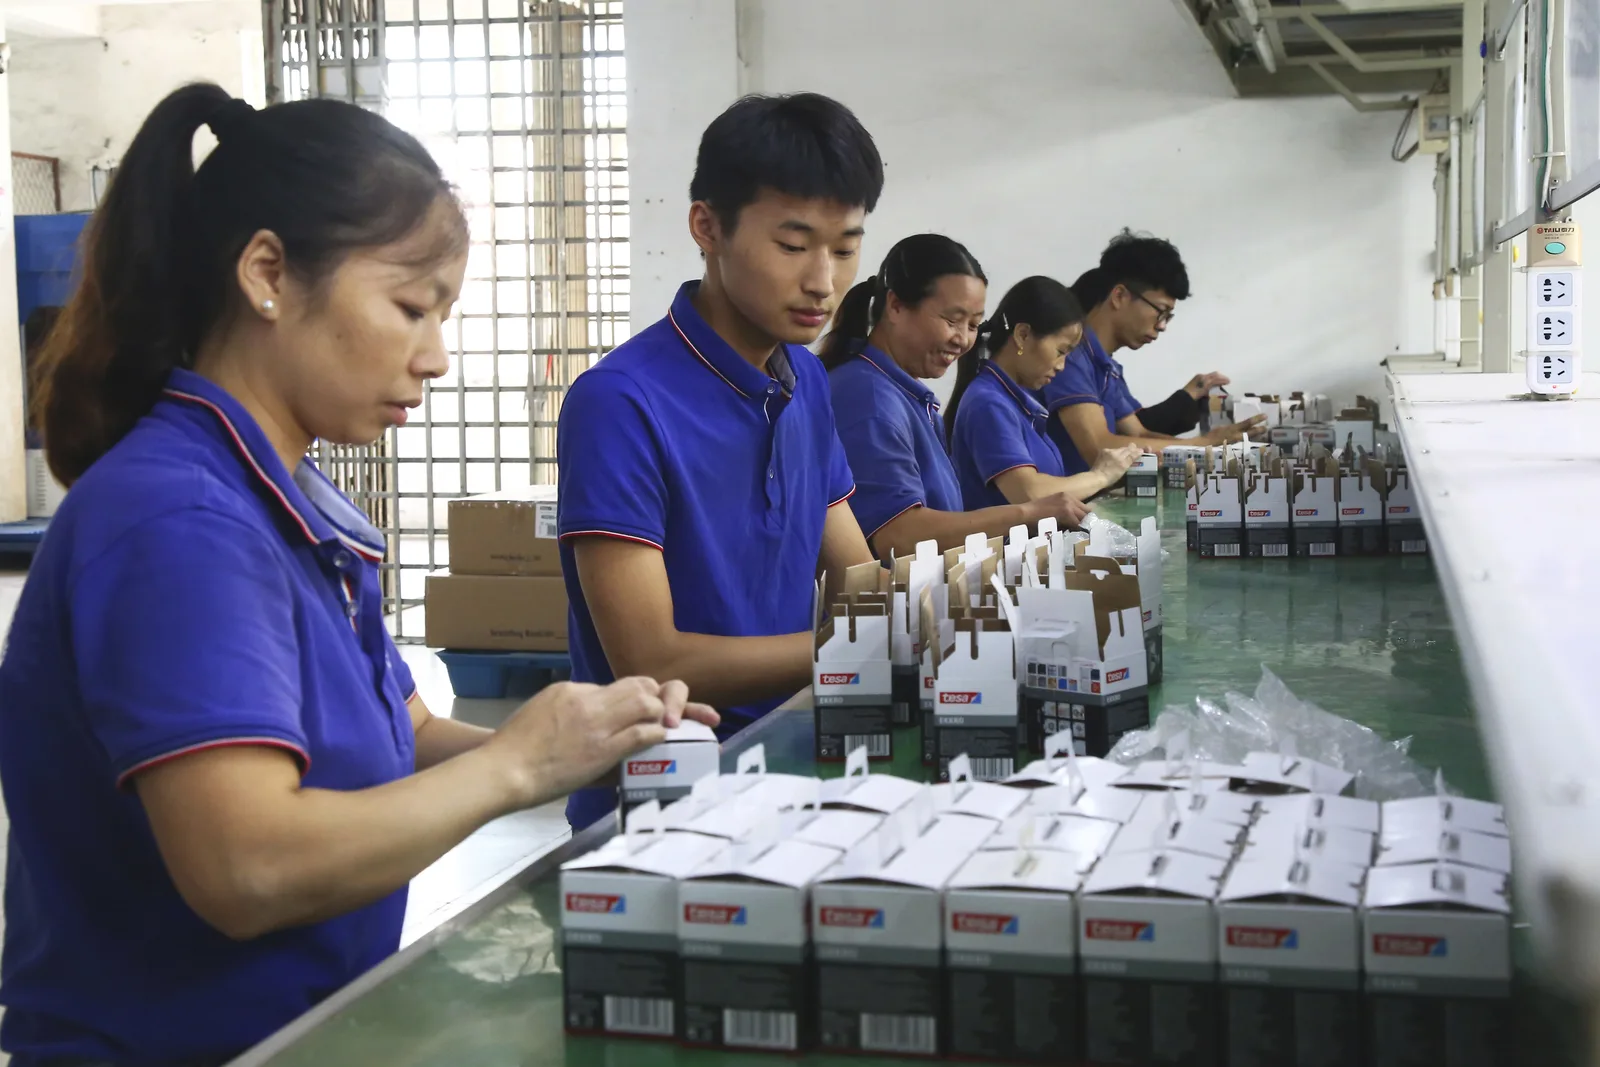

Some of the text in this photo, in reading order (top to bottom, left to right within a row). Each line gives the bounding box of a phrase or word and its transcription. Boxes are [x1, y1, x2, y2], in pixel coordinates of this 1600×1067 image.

[823, 674, 848, 684] tesa
[1107, 671, 1123, 681] tesa
[942, 693, 969, 703] tesa
[631, 762, 663, 774] tesa
[570, 895, 608, 912] tesa
[689, 906, 728, 924] tesa
[825, 908, 866, 926] tesa
[957, 915, 999, 933] tesa
[1091, 922, 1134, 941] tesa
[1232, 929, 1277, 947] tesa
